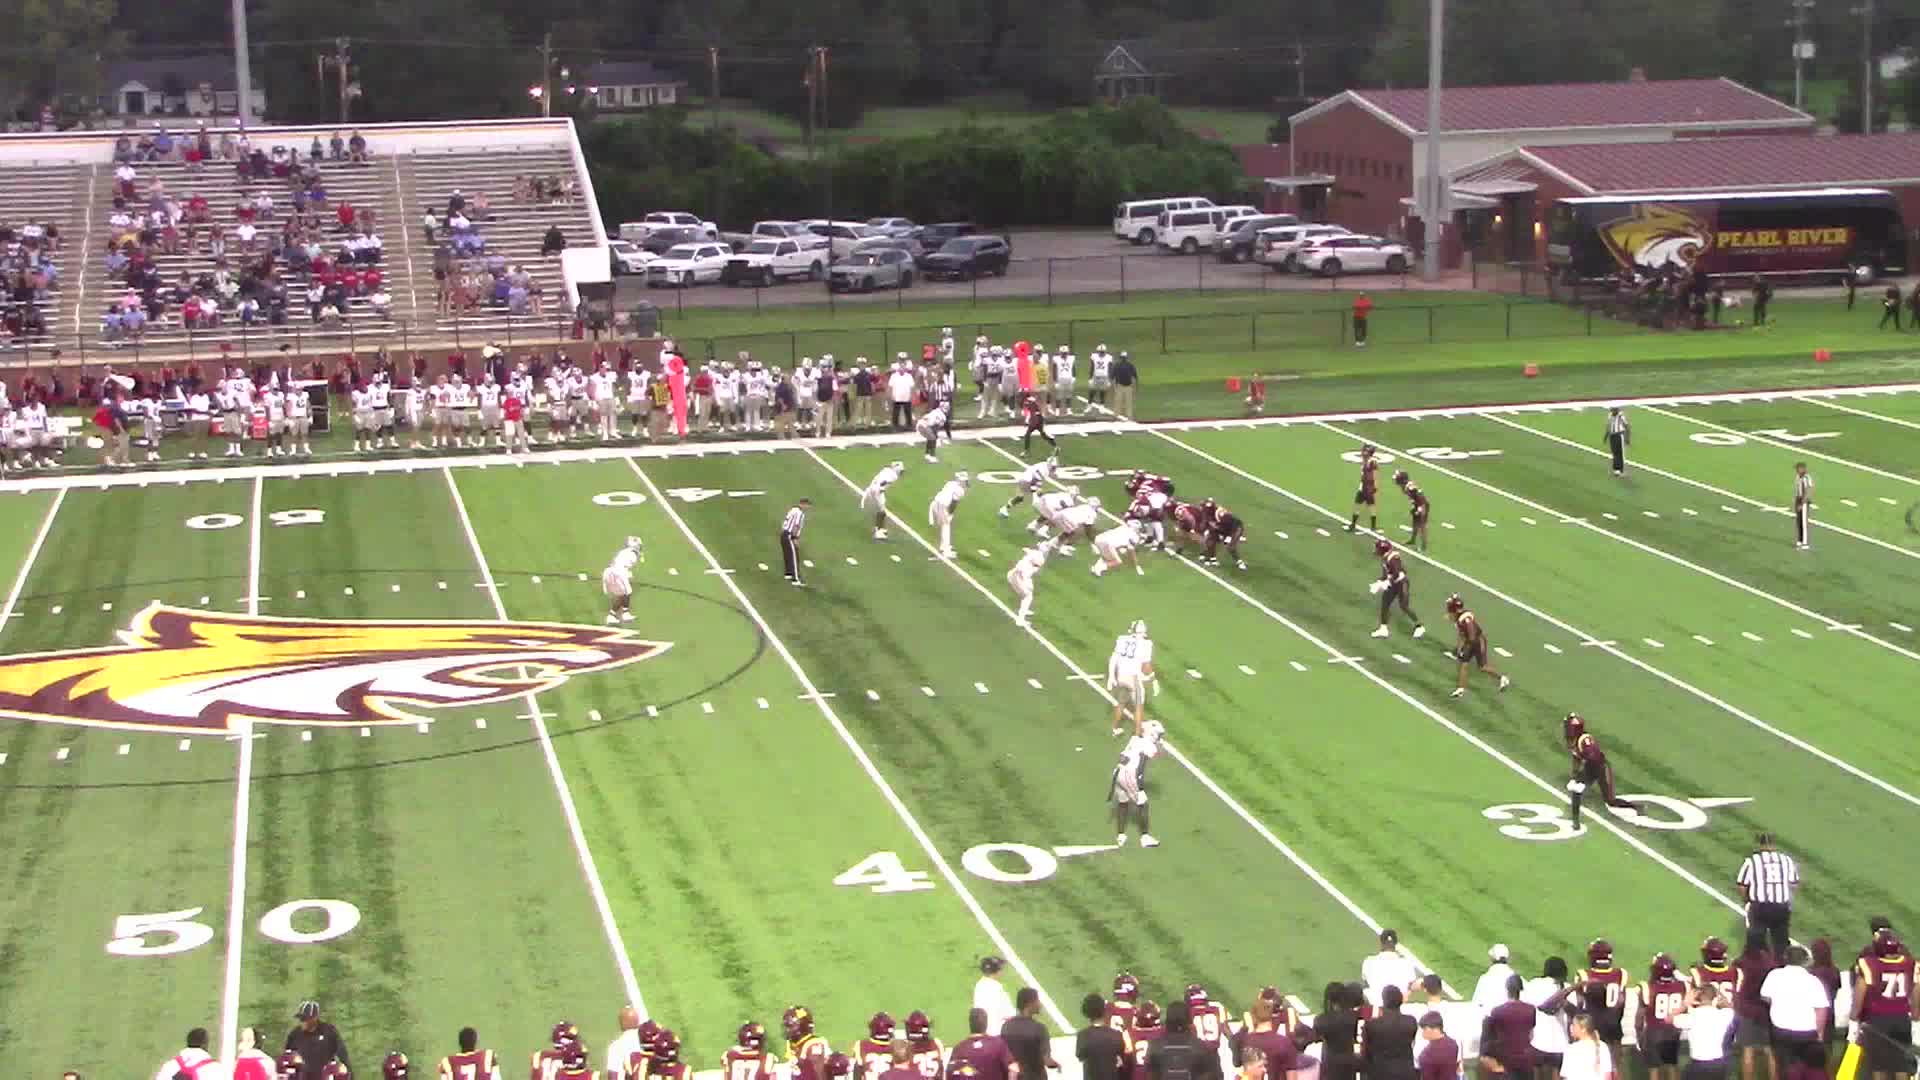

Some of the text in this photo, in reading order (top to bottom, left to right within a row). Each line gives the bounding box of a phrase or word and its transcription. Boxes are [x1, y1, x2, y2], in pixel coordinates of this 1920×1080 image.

[1717, 227, 1849, 249] PEARL RIVER
[1881, 973, 1906, 998] 71
[1192, 1013, 1219, 1042] 19
